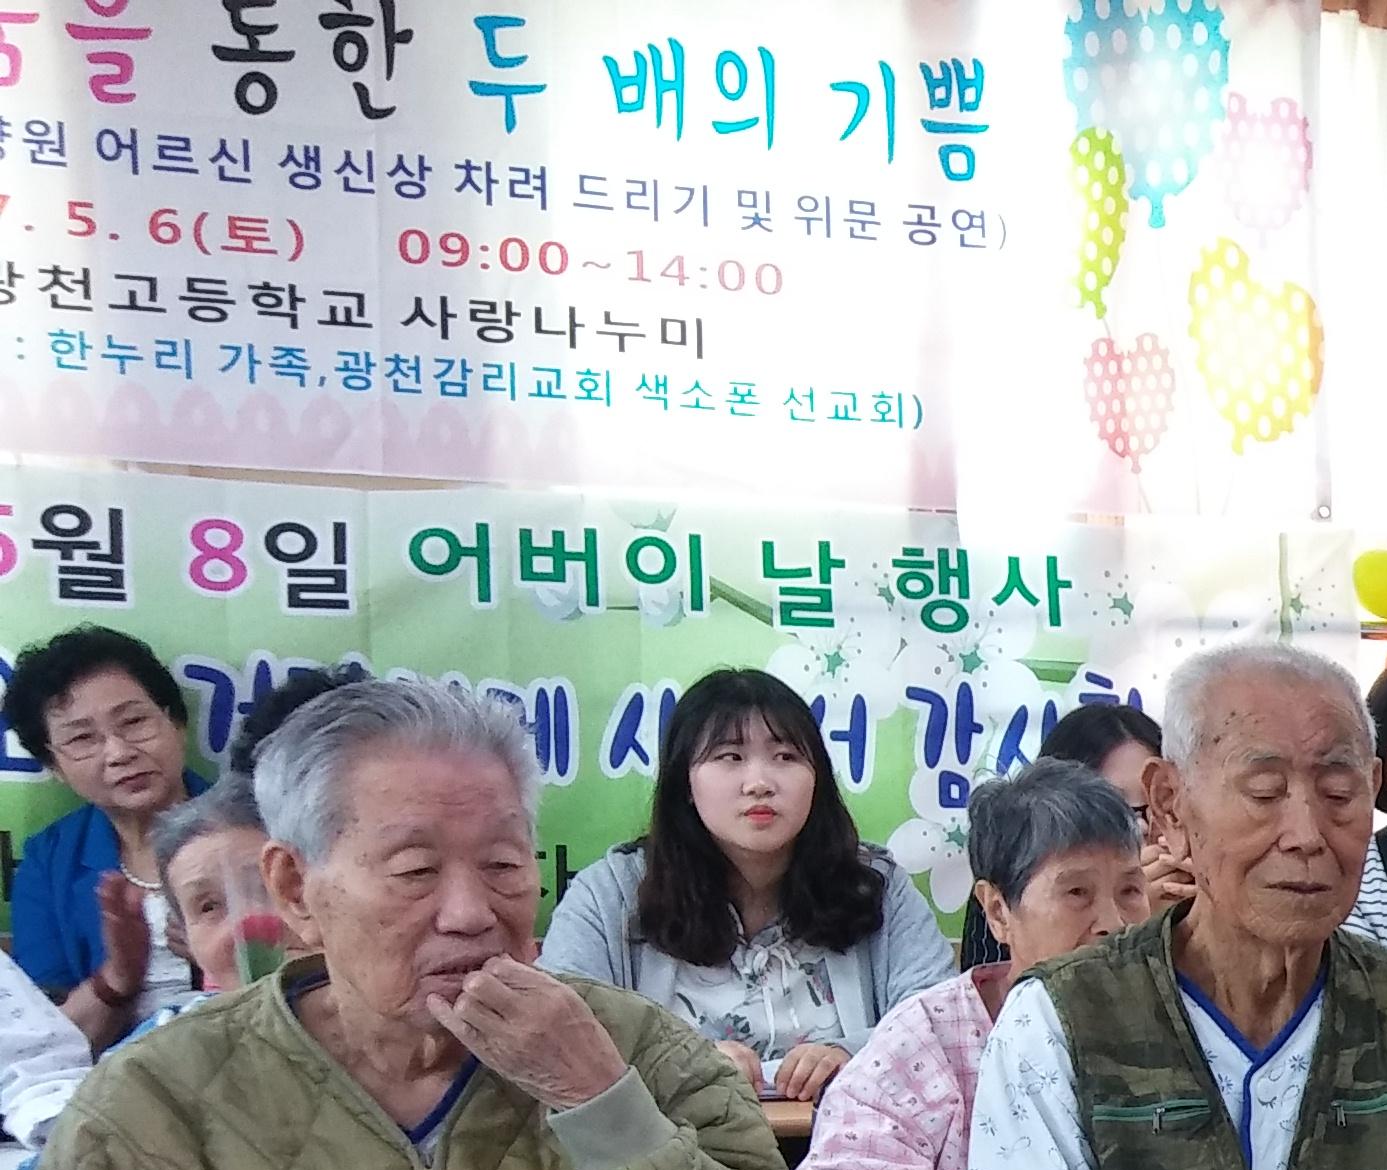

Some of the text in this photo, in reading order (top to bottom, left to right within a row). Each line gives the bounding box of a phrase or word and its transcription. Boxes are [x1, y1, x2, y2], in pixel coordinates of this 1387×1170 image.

[468, 15, 548, 135] 두
[601, 36, 776, 151] 배의
[829, 57, 990, 182] 기쁨
[0, 116, 1006, 249] 원 어르신 생신상 차려 드리기 및 위문 공연)
[48, 329, 192, 380] 한누리
[218, 342, 611, 407] 가족,광천감리교회
[635, 373, 760, 416] 색소폰
[783, 387, 923, 430] 선교회)
[400, 296, 703, 360] 사랑나누미
[188, 519, 349, 609] 8일
[409, 522, 704, 612] 어버이
[762, 540, 846, 628] 날
[891, 546, 1072, 634] 행사
